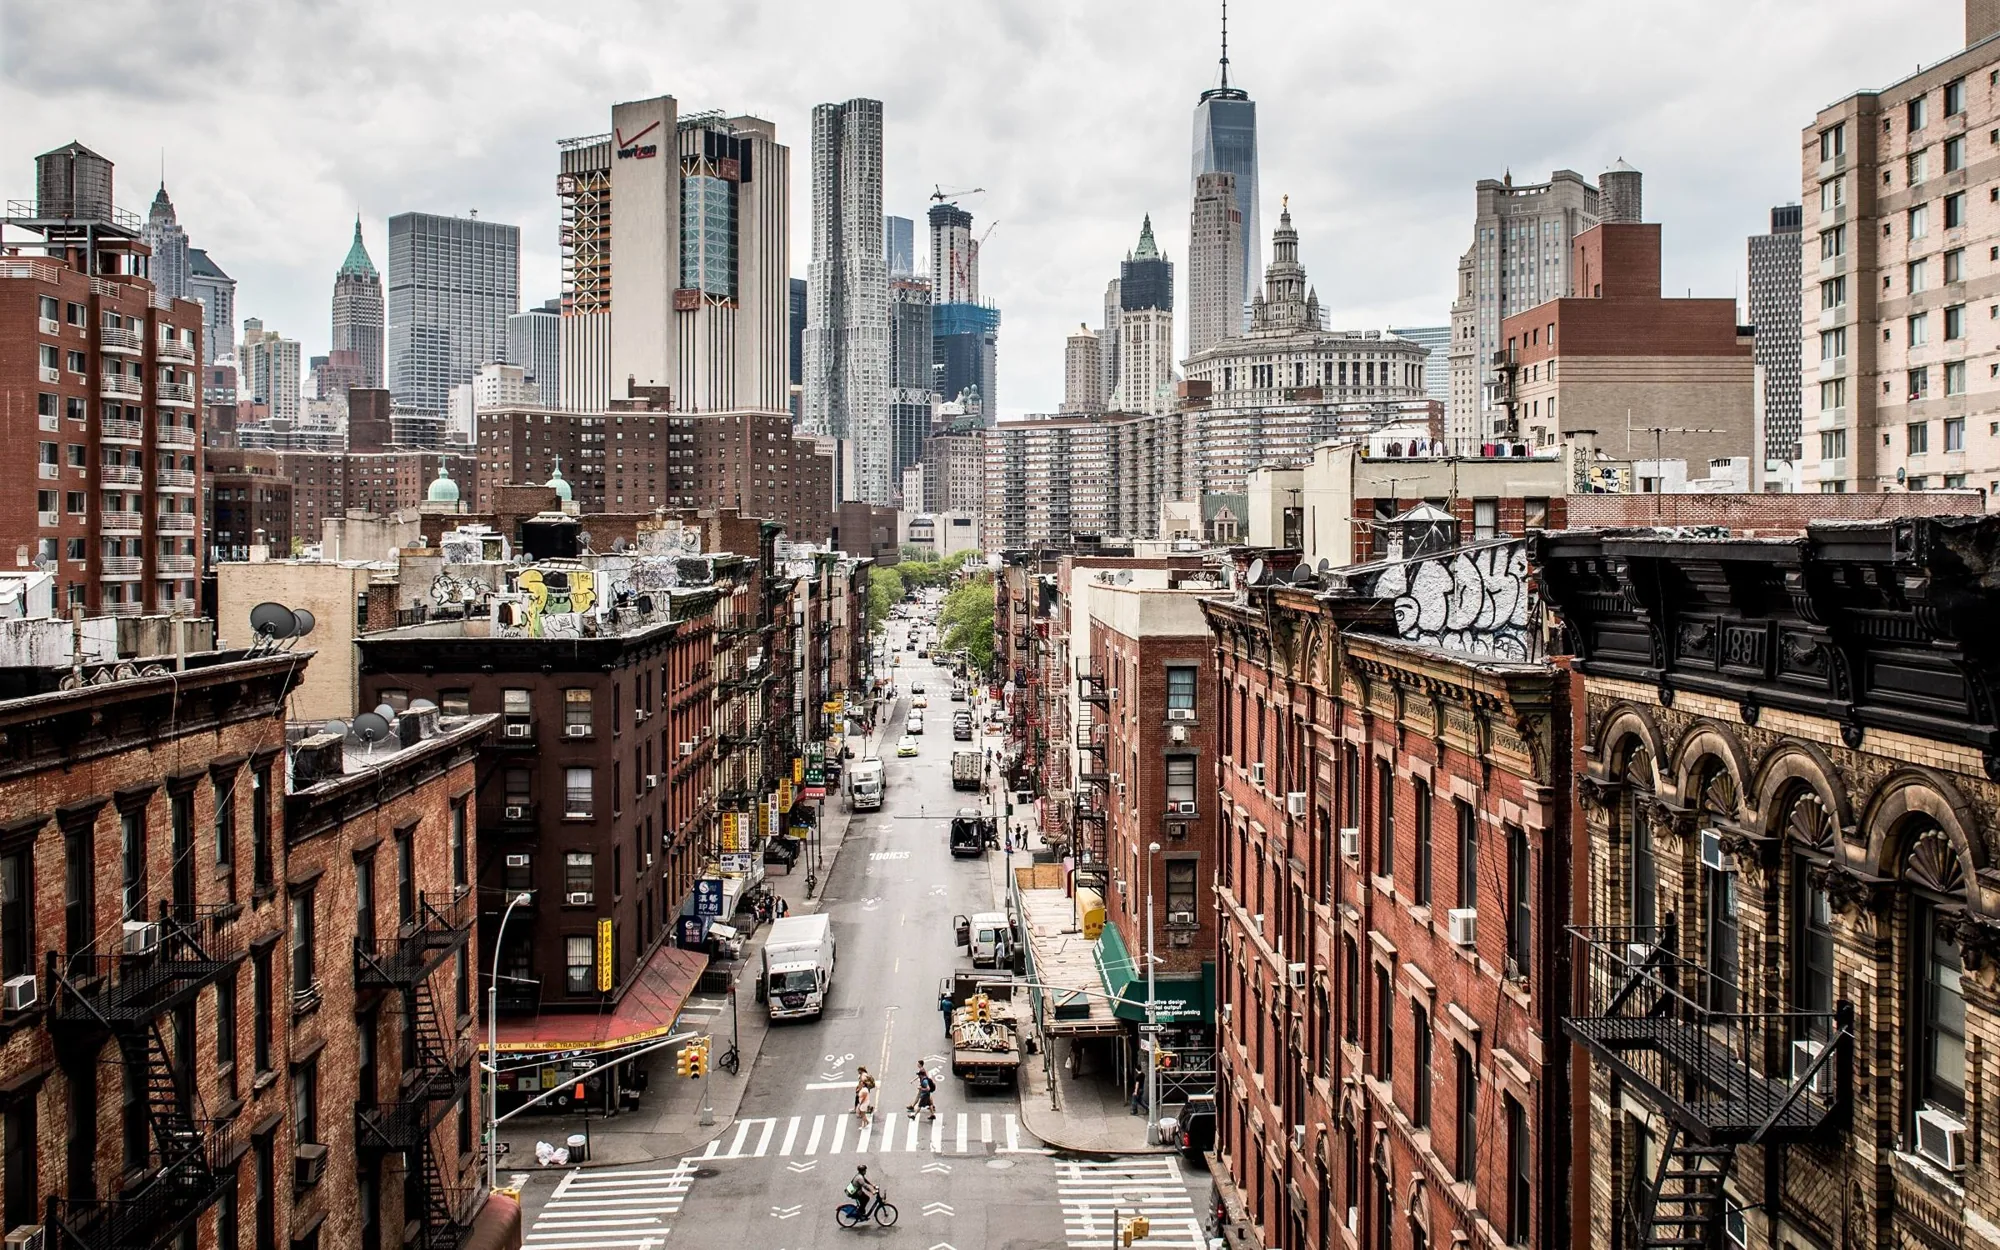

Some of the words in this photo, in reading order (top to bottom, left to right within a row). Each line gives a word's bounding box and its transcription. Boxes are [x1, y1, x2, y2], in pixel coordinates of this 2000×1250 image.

[617, 144, 657, 159] verizon
[1725, 629, 1760, 665] 1891
[869, 851, 911, 861] SCHOOL
